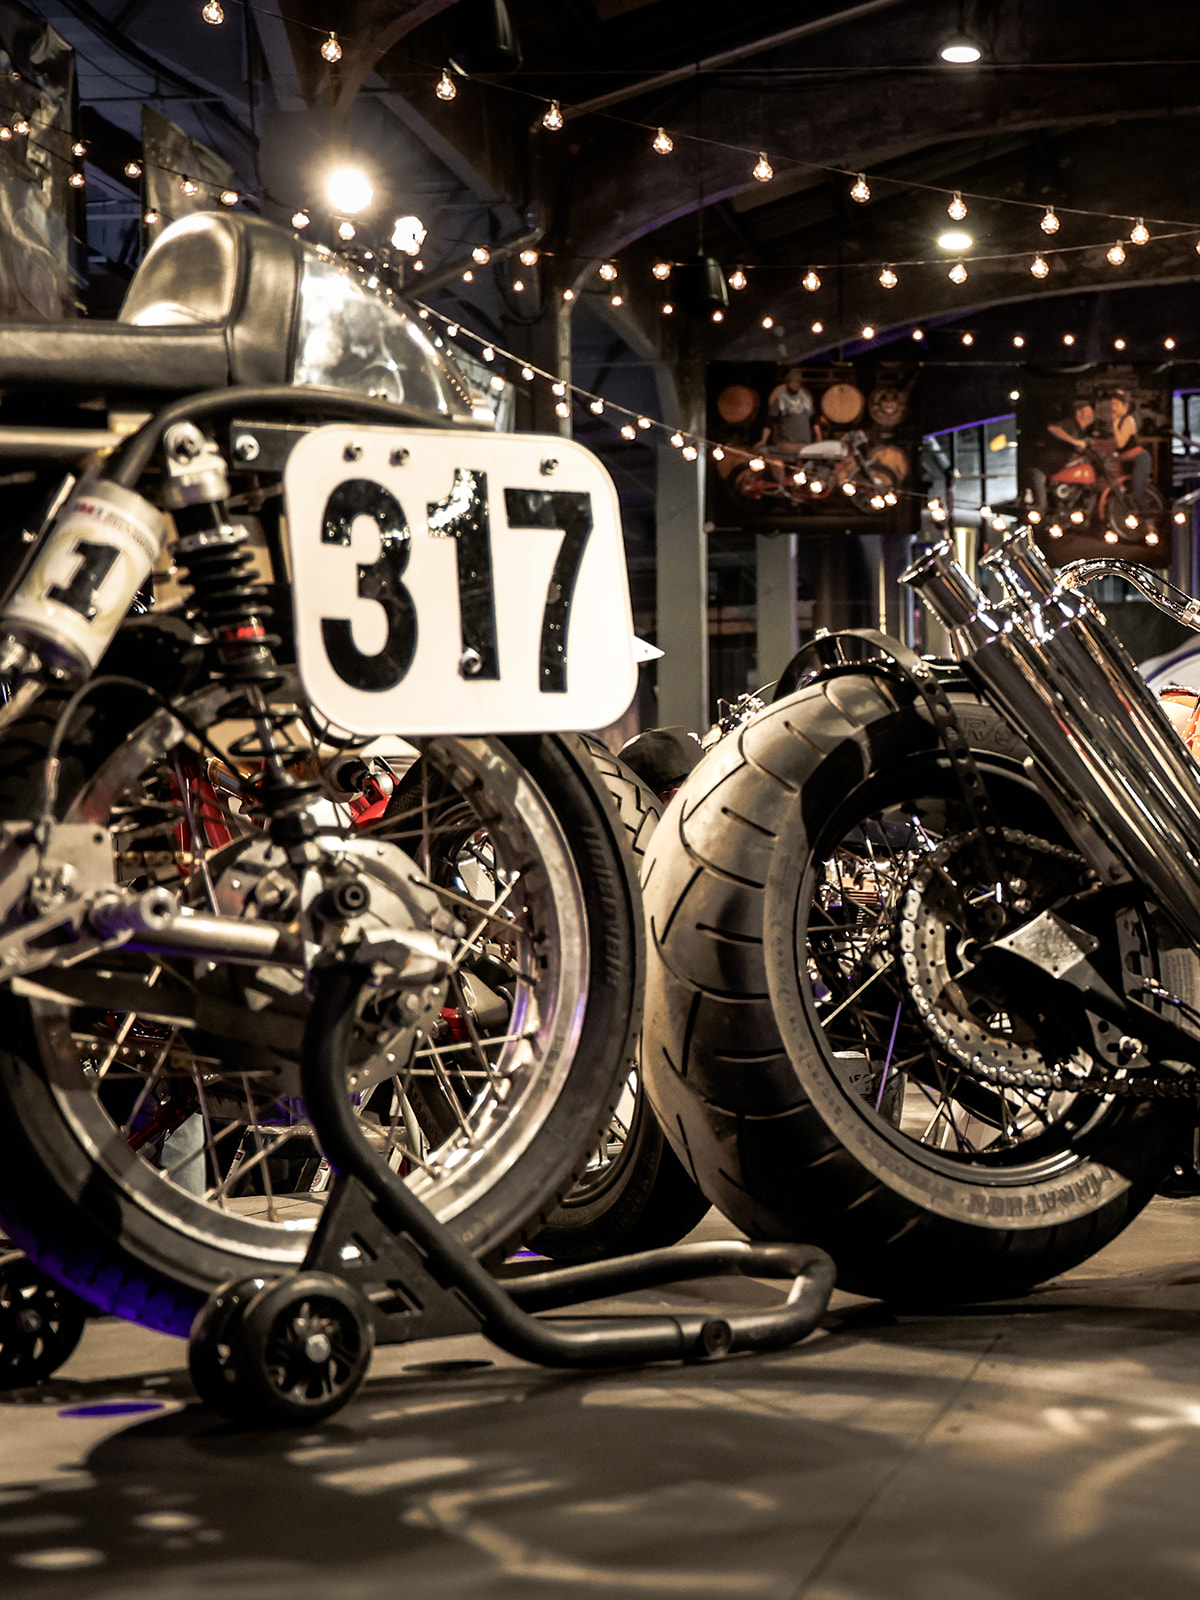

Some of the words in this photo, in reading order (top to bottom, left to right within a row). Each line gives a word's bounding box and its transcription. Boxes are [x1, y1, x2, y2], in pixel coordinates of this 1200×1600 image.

[47, 539, 121, 621] 1
[321, 468, 593, 693] 317
[967, 1166, 1113, 1217] MARATHON
